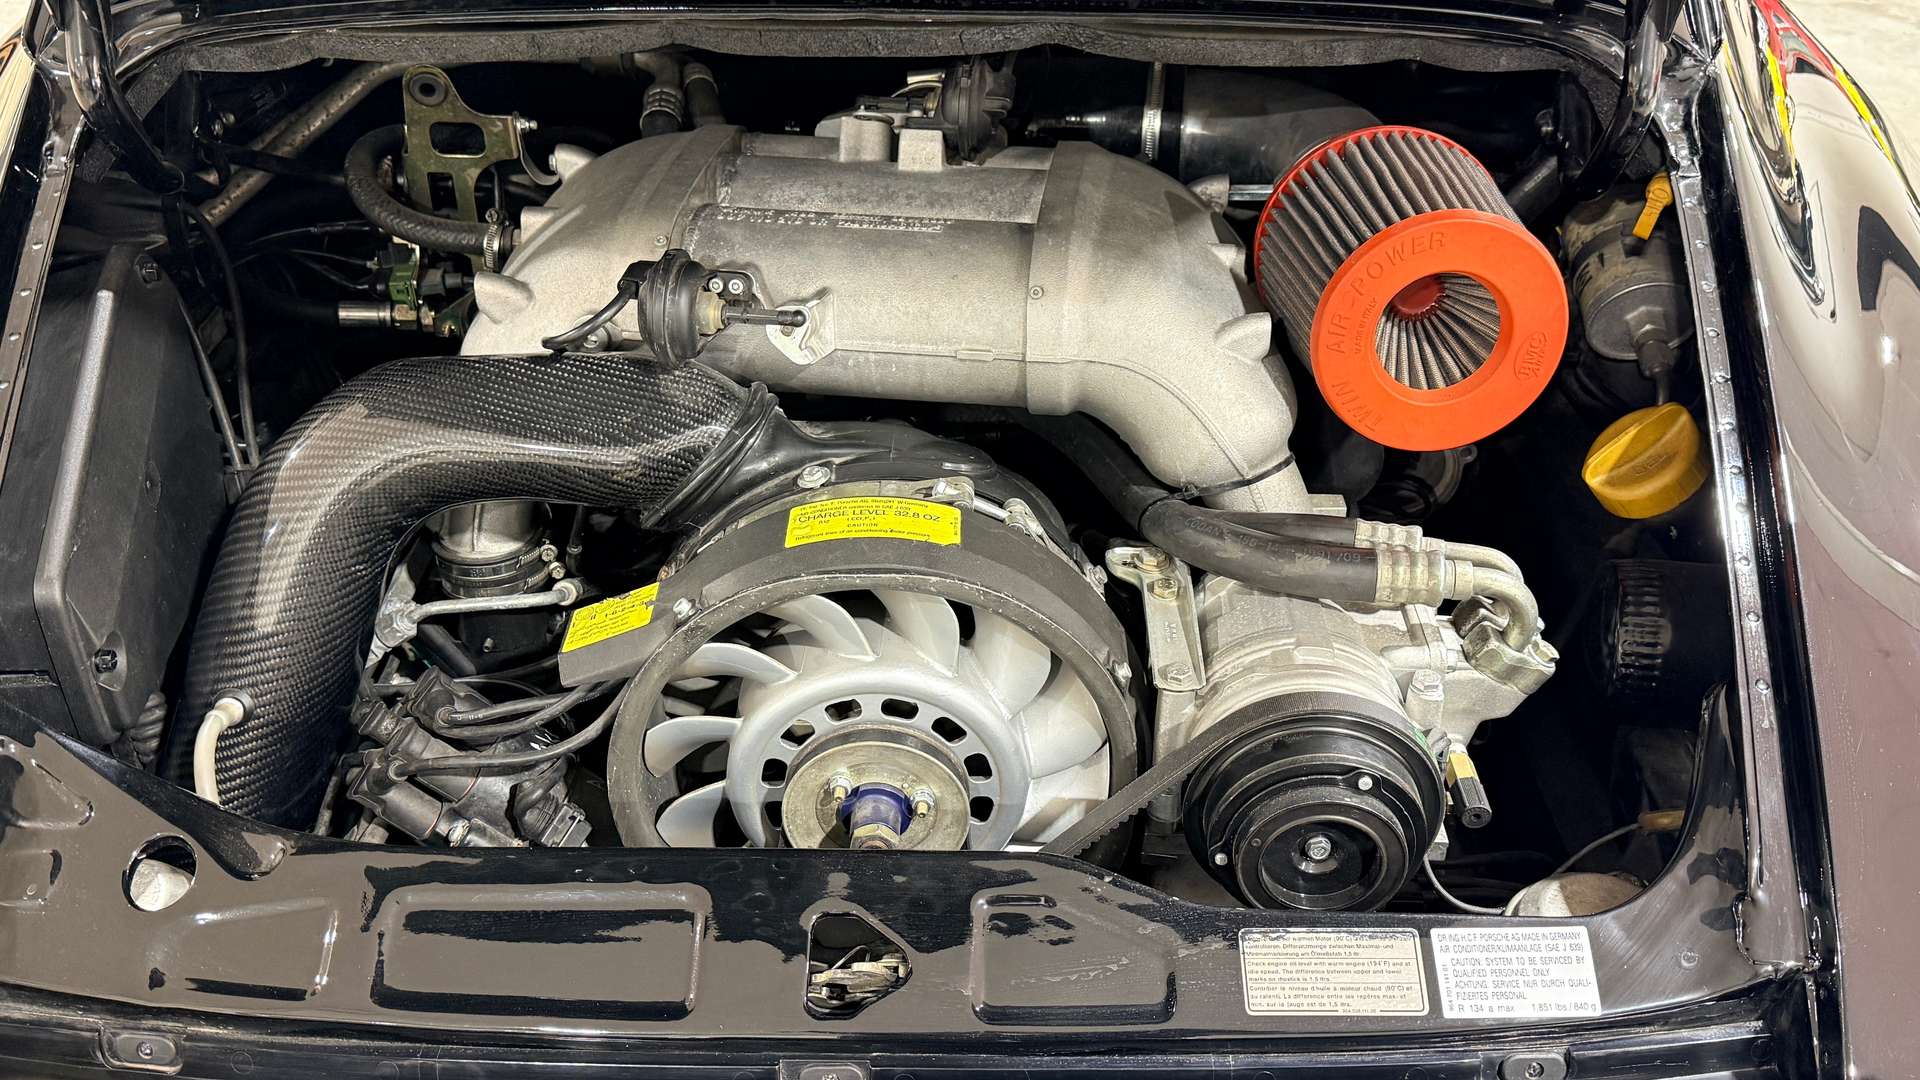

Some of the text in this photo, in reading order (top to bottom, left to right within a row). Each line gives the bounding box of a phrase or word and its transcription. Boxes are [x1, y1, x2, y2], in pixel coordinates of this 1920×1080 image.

[1331, 383, 1384, 433] TWIN
[798, 510, 849, 523] CHARGE
[894, 510, 920, 519] 32.8
[923, 513, 941, 521] OZ
[1479, 932, 1511, 942] PORSCHE
[1511, 932, 1521, 942] AG
[1521, 932, 1541, 941] MADE
[1541, 931, 1549, 941] IN
[1549, 931, 1581, 941] GERMANY
[1439, 944, 1451, 954] AIR
[1485, 956, 1513, 967] SYSTEM
[1515, 956, 1526, 966] TO
[1528, 956, 1538, 966] BE
[1540, 955, 1573, 966] SERVICED
[1575, 955, 1585, 965] BY
[1452, 967, 1550, 978] QUALIFIED PERSONNEL ONLY
[1492, 979, 1520, 989] SERVICE
[1523, 978, 1538, 988] NUR
[1541, 978, 1566, 988] DURCH
[1568, 977, 1592, 988] QUALI-
[1456, 991, 1489, 1001] FIZIERTES
[1458, 1003, 1465, 1013] R
[1470, 1003, 1484, 1013] 134
[1488, 1005, 1494, 1013] a
[1555, 1002, 1568, 1012] lbs
[1574, 1001, 1589, 1012] 840
[1591, 1002, 1597, 1012] g
